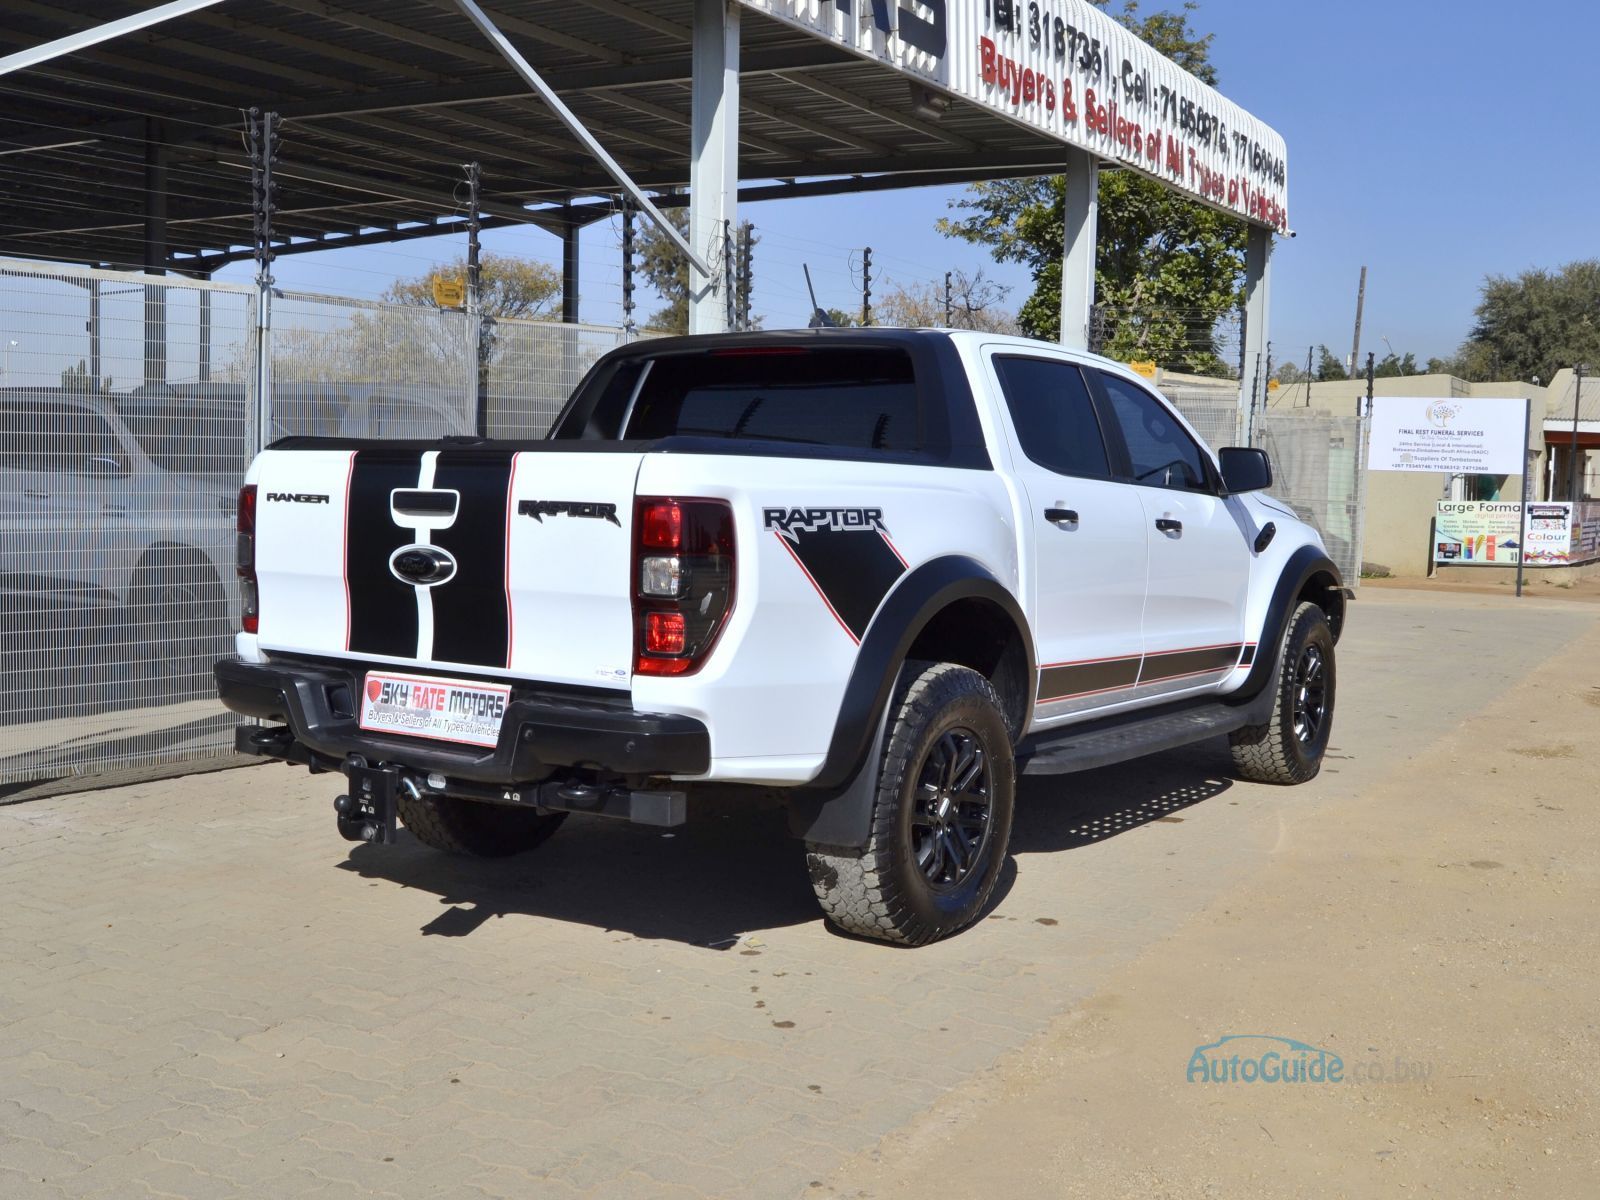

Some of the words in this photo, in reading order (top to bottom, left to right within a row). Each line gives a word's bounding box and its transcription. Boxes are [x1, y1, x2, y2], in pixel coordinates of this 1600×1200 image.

[980, 35, 1055, 111] Buyers
[1063, 78, 1077, 122] &
[1085, 88, 1143, 154] Sellers
[1147, 128, 1161, 165] of
[1166, 134, 1184, 181] All
[267, 493, 329, 504] RANGER
[1438, 502, 1475, 513] Large
[1480, 502, 1521, 512] Forma
[518, 500, 621, 528] RAPTOR
[762, 507, 892, 541] RAPTOR
[1527, 533, 1566, 541] Colour
[381, 682, 409, 707] SKY
[412, 685, 446, 712] GATE
[449, 689, 505, 719] MOTORS
[368, 709, 392, 724] Buyers
[393, 714, 399, 724] &
[401, 713, 424, 727] Sellers
[424, 717, 432, 727] of
[433, 718, 442, 729] All
[444, 719, 464, 733] Types
